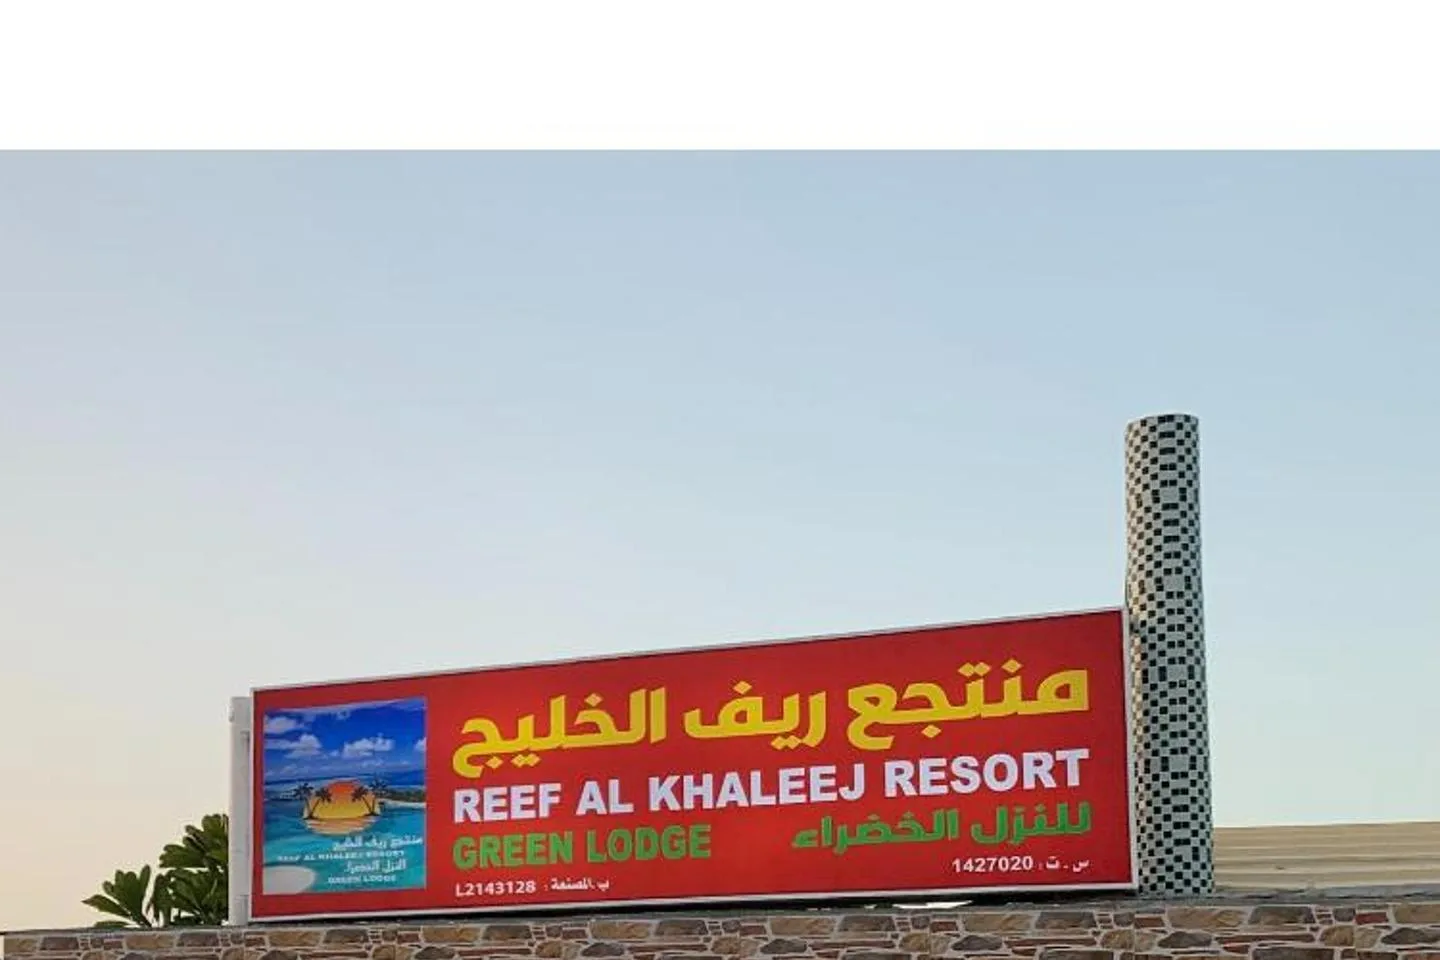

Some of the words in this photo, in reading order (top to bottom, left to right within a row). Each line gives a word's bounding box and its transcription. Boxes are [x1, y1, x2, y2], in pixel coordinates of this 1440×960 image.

[452, 686, 667, 779] الخليج
[683, 680, 827, 750] ريف
[847, 658, 1090, 750] منتجع
[453, 782, 562, 824] REEF
[575, 778, 635, 817] AL
[648, 763, 865, 812] KHALEEJ
[883, 748, 1090, 798] RESORT
[452, 830, 574, 871] GREEN
[586, 822, 712, 865] LODGE
[792, 807, 960, 856] الخضراء
[454, 879, 537, 898] L2143128
[951, 854, 1034, 874] 1427020
